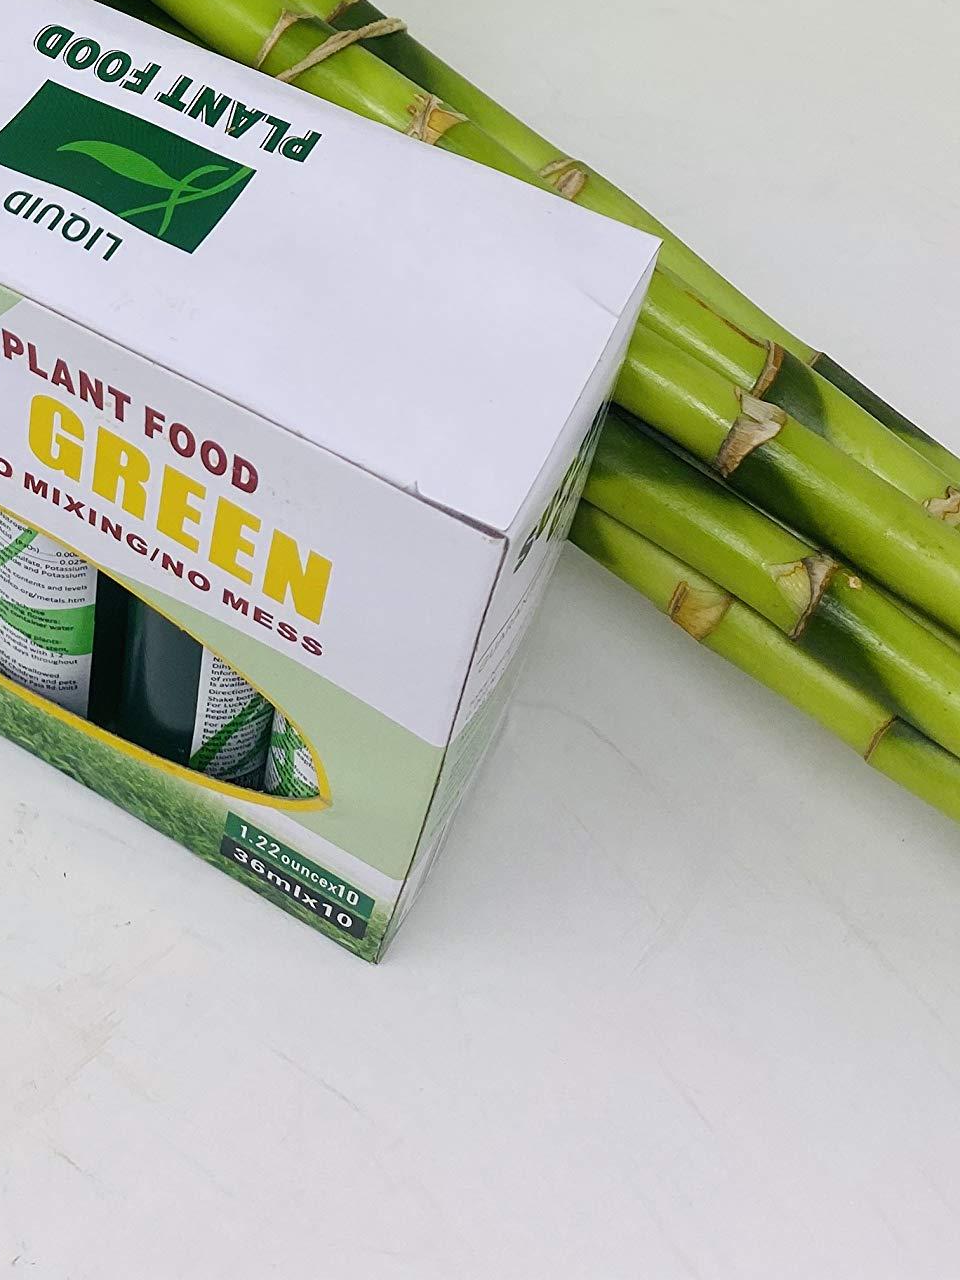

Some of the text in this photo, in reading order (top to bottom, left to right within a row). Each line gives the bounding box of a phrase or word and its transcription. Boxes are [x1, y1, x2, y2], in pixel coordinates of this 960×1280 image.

[33, 24, 322, 162] PLANT FOOD
[3, 190, 123, 261] LIQUID
[1, 328, 259, 494] PLANT FOOD
[28, 394, 333, 625] GREEN
[23, 472, 211, 592] MIXING/NO
[222, 588, 323, 656] MESS
[23, 565, 87, 579] and Potassium
[45, 564, 88, 572] Potassium
[30, 653, 78, 666] throughout
[233, 847, 353, 928] 36mlx10
[241, 824, 359, 906] 1.22ouncex10
